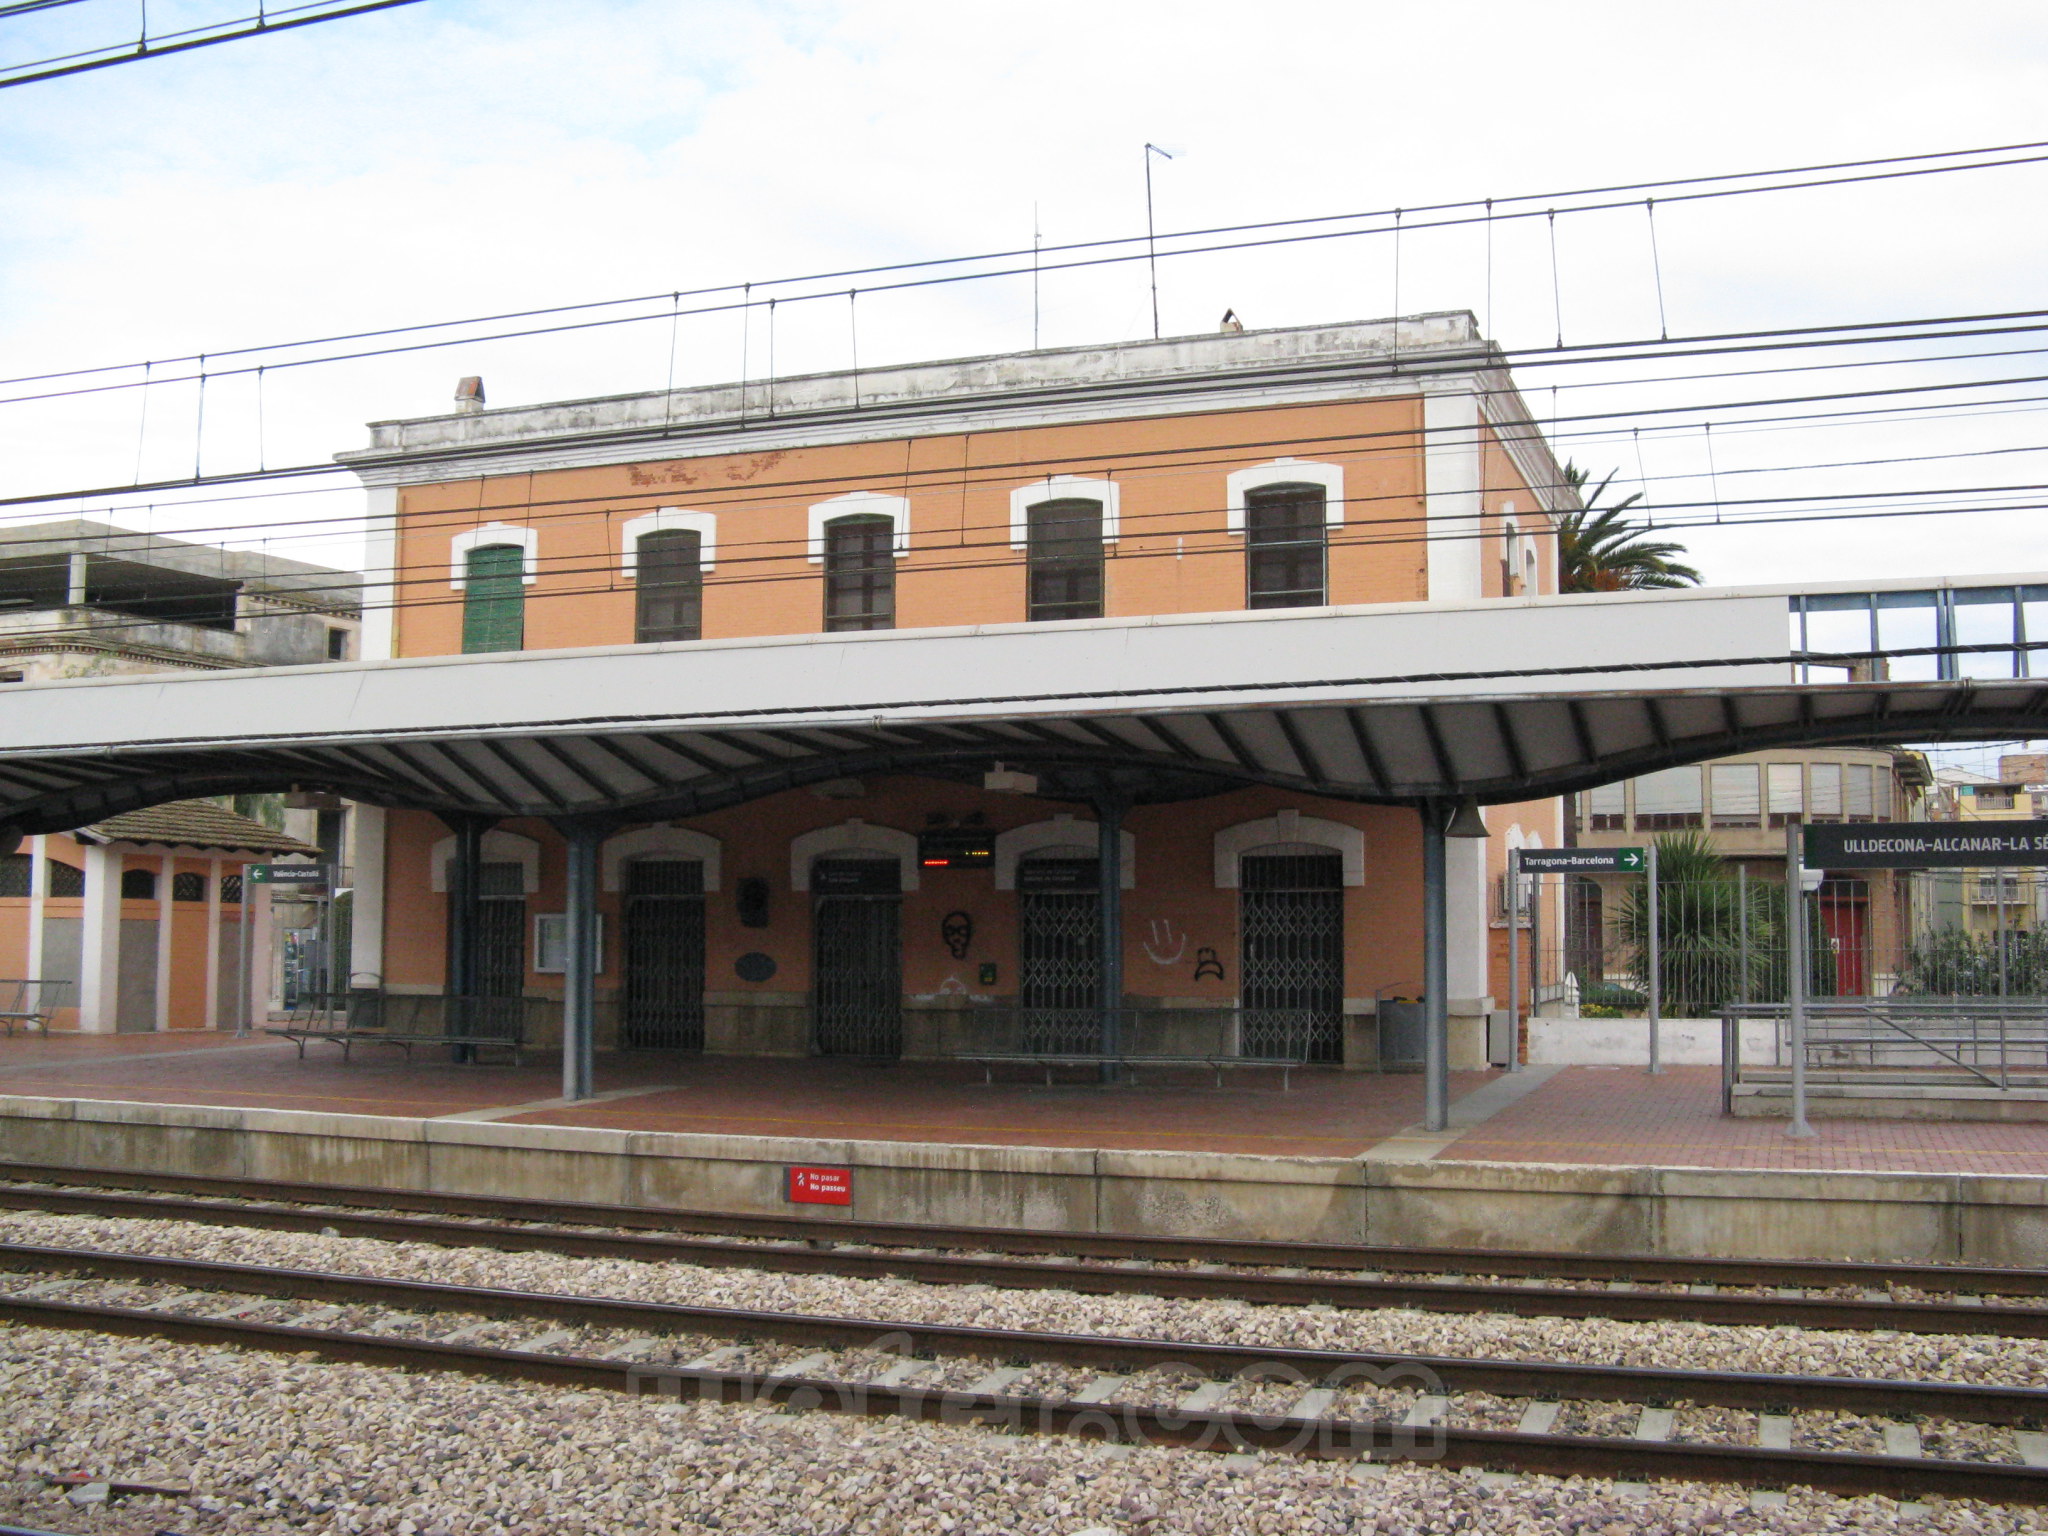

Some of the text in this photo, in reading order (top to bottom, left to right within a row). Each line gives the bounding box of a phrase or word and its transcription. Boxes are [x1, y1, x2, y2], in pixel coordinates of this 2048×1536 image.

[1525, 856, 1614, 867] Tarragona-Barcelona
[810, 1173, 840, 1183] No pasar
[810, 1183, 846, 1193] No passeu
